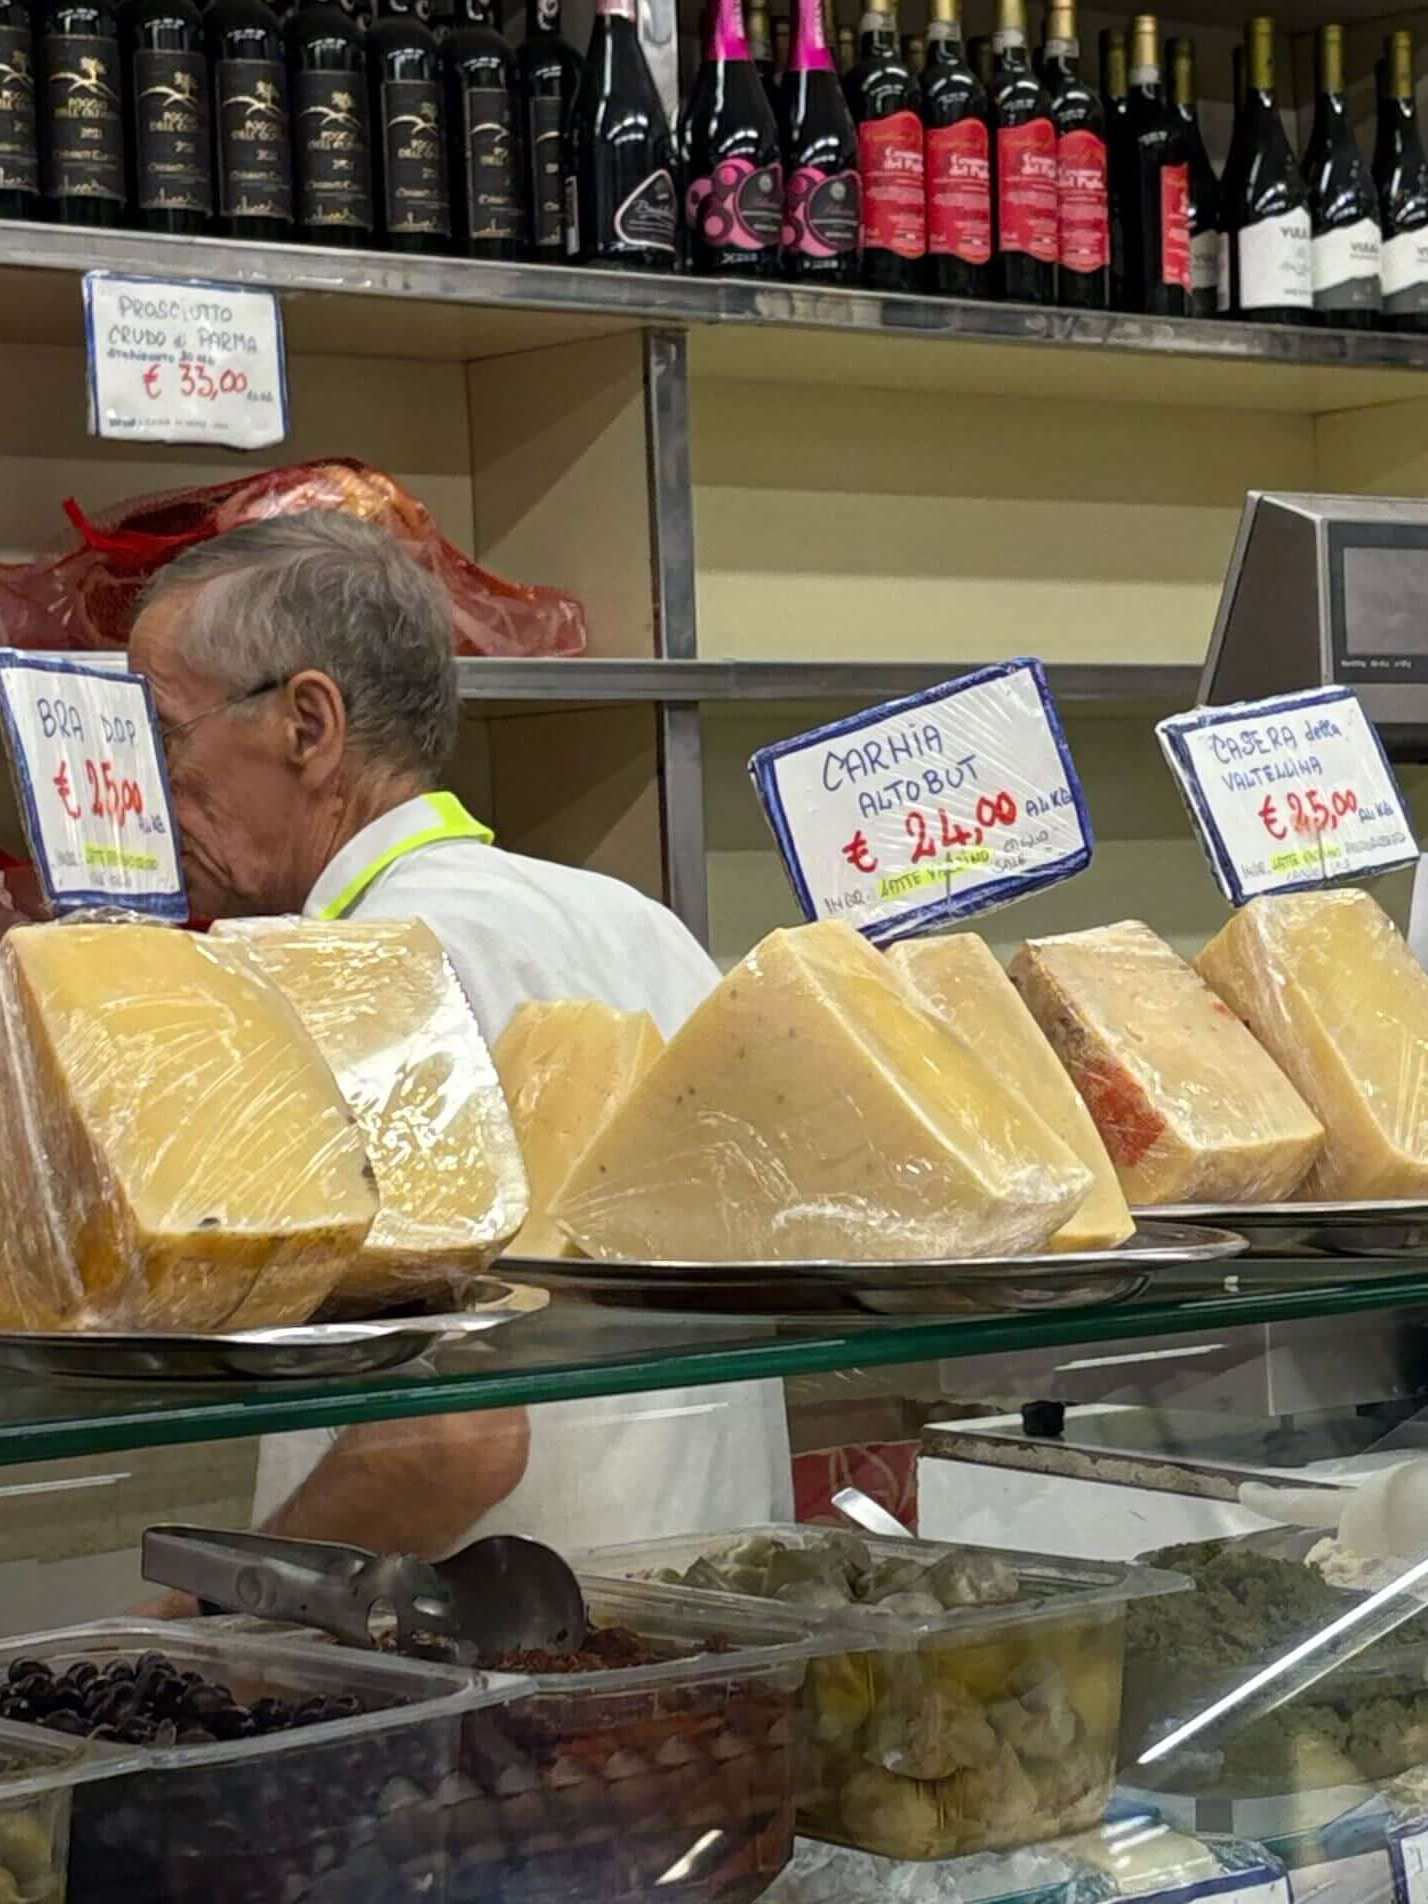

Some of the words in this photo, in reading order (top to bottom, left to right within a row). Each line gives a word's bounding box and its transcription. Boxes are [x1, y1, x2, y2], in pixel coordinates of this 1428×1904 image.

[118, 296, 233, 322] PROSCIUTTO
[108, 326, 167, 347] CRUDO
[199, 328, 258, 354] PARMA
[143, 364, 164, 400] €
[178, 363, 248, 401] 33,00
[36, 698, 84, 743] BRA
[822, 722, 944, 792] CARNIA
[1212, 727, 1298, 764] CASERA
[85, 759, 144, 827] 25,00
[858, 755, 980, 819] ALTOBUT
[1222, 756, 1324, 793] VALTELLINA
[841, 829, 879, 874] €
[906, 791, 1017, 863] 24,00
[1258, 794, 1288, 840] €
[1286, 789, 1359, 833] 25,00
